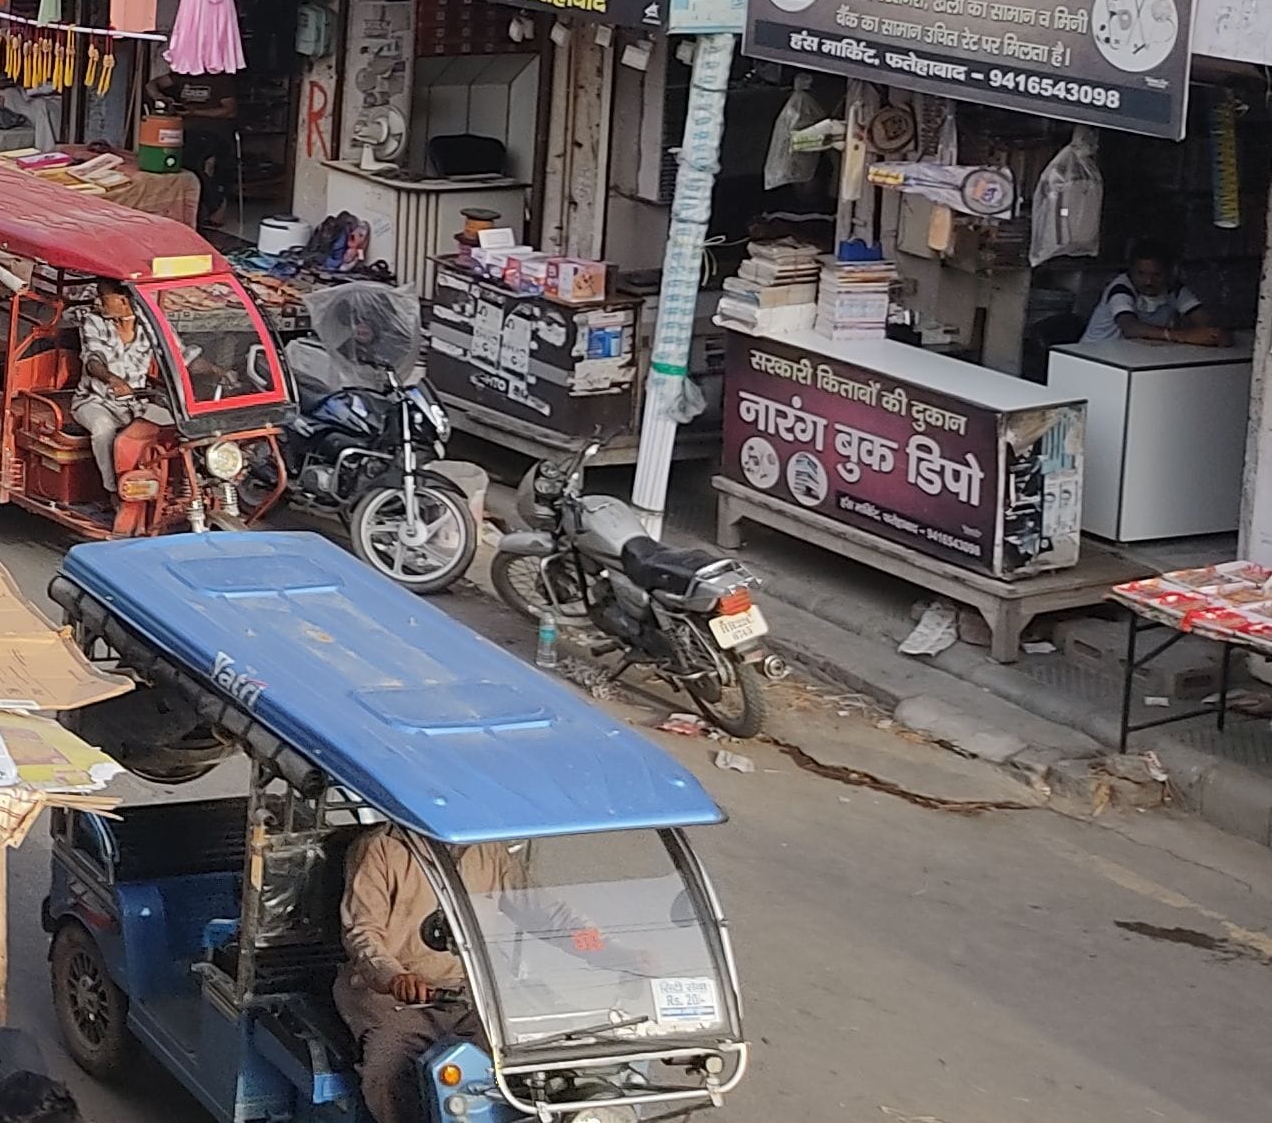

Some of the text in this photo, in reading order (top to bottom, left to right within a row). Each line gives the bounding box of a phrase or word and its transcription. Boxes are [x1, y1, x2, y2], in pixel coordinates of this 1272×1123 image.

[861, 14, 880, 33] का
[881, 18, 923, 41] सामान
[924, 21, 959, 47] उचित
[960, 28, 980, 52] रेट
[982, 35, 1002, 55] पर
[1002, 35, 1050, 62] मिलता
[967, 0, 988, 19] का
[990, 3, 1036, 26] सामान
[1039, 11, 1050, 28] व
[1053, 6, 1089, 34] मिनी
[789, 32, 819, 52] हंस
[820, 41, 881, 67] मार्किट,
[988, 68, 1122, 110] 9416543098
[306, 80, 329, 160] R
[749, 349, 968, 437] सरकारी किताबों की दुकान
[737, 391, 986, 508] नारंग बुक डिपो
[213, 651, 262, 707] Yatri
[666, 995, 683, 1007] Rs.
